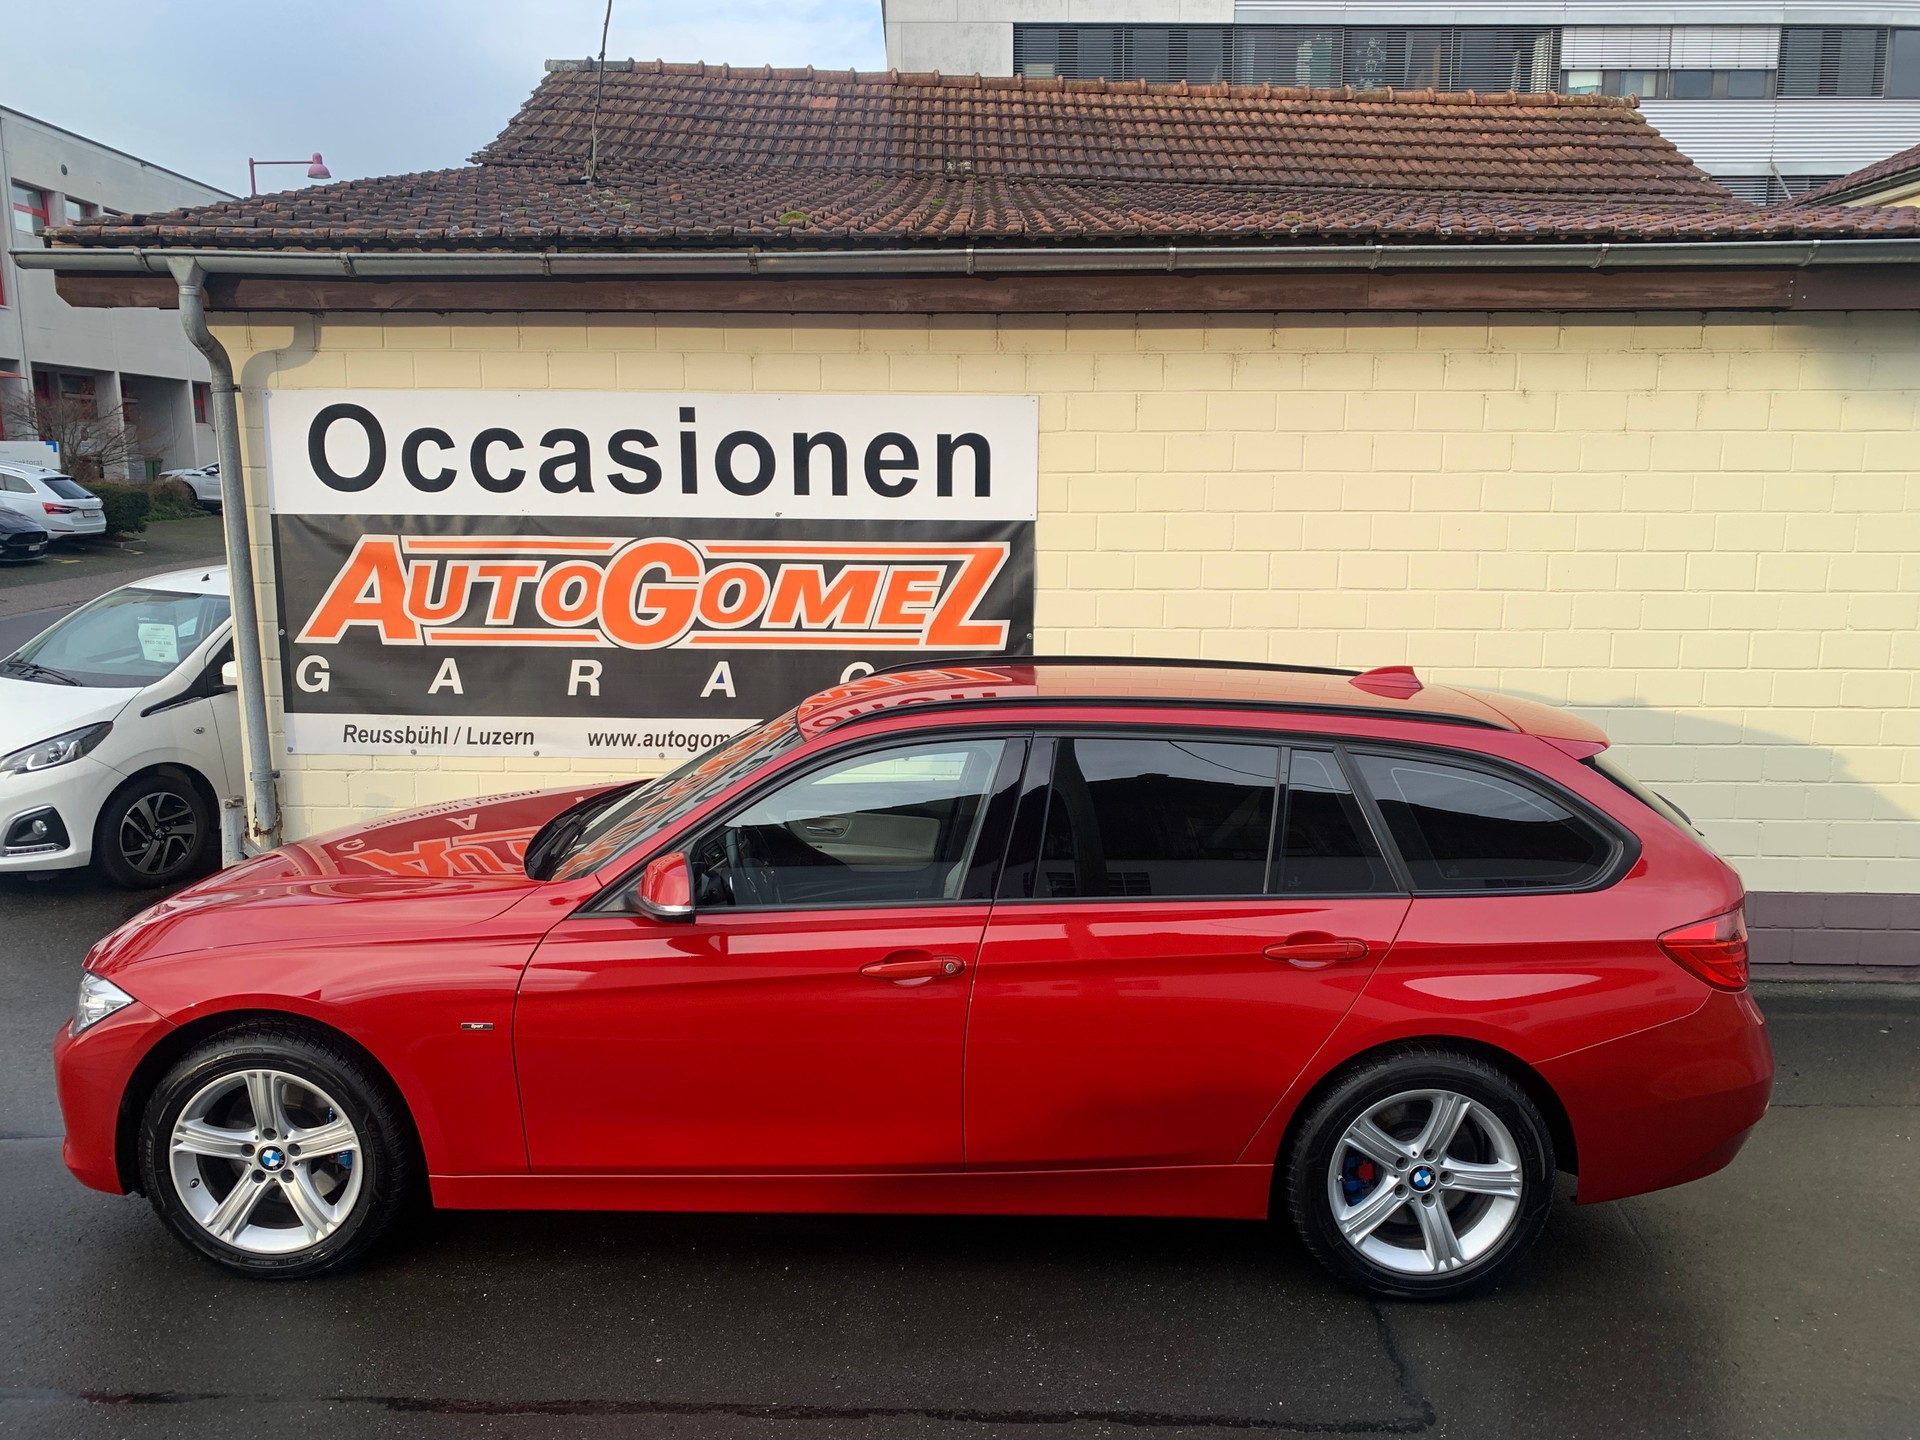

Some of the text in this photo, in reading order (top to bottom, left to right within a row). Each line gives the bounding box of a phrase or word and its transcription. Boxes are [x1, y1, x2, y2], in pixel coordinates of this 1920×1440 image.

[308, 403, 991, 498] Occasionen
[343, 724, 448, 745] Reussbühl
[466, 726, 535, 745] Luzern
